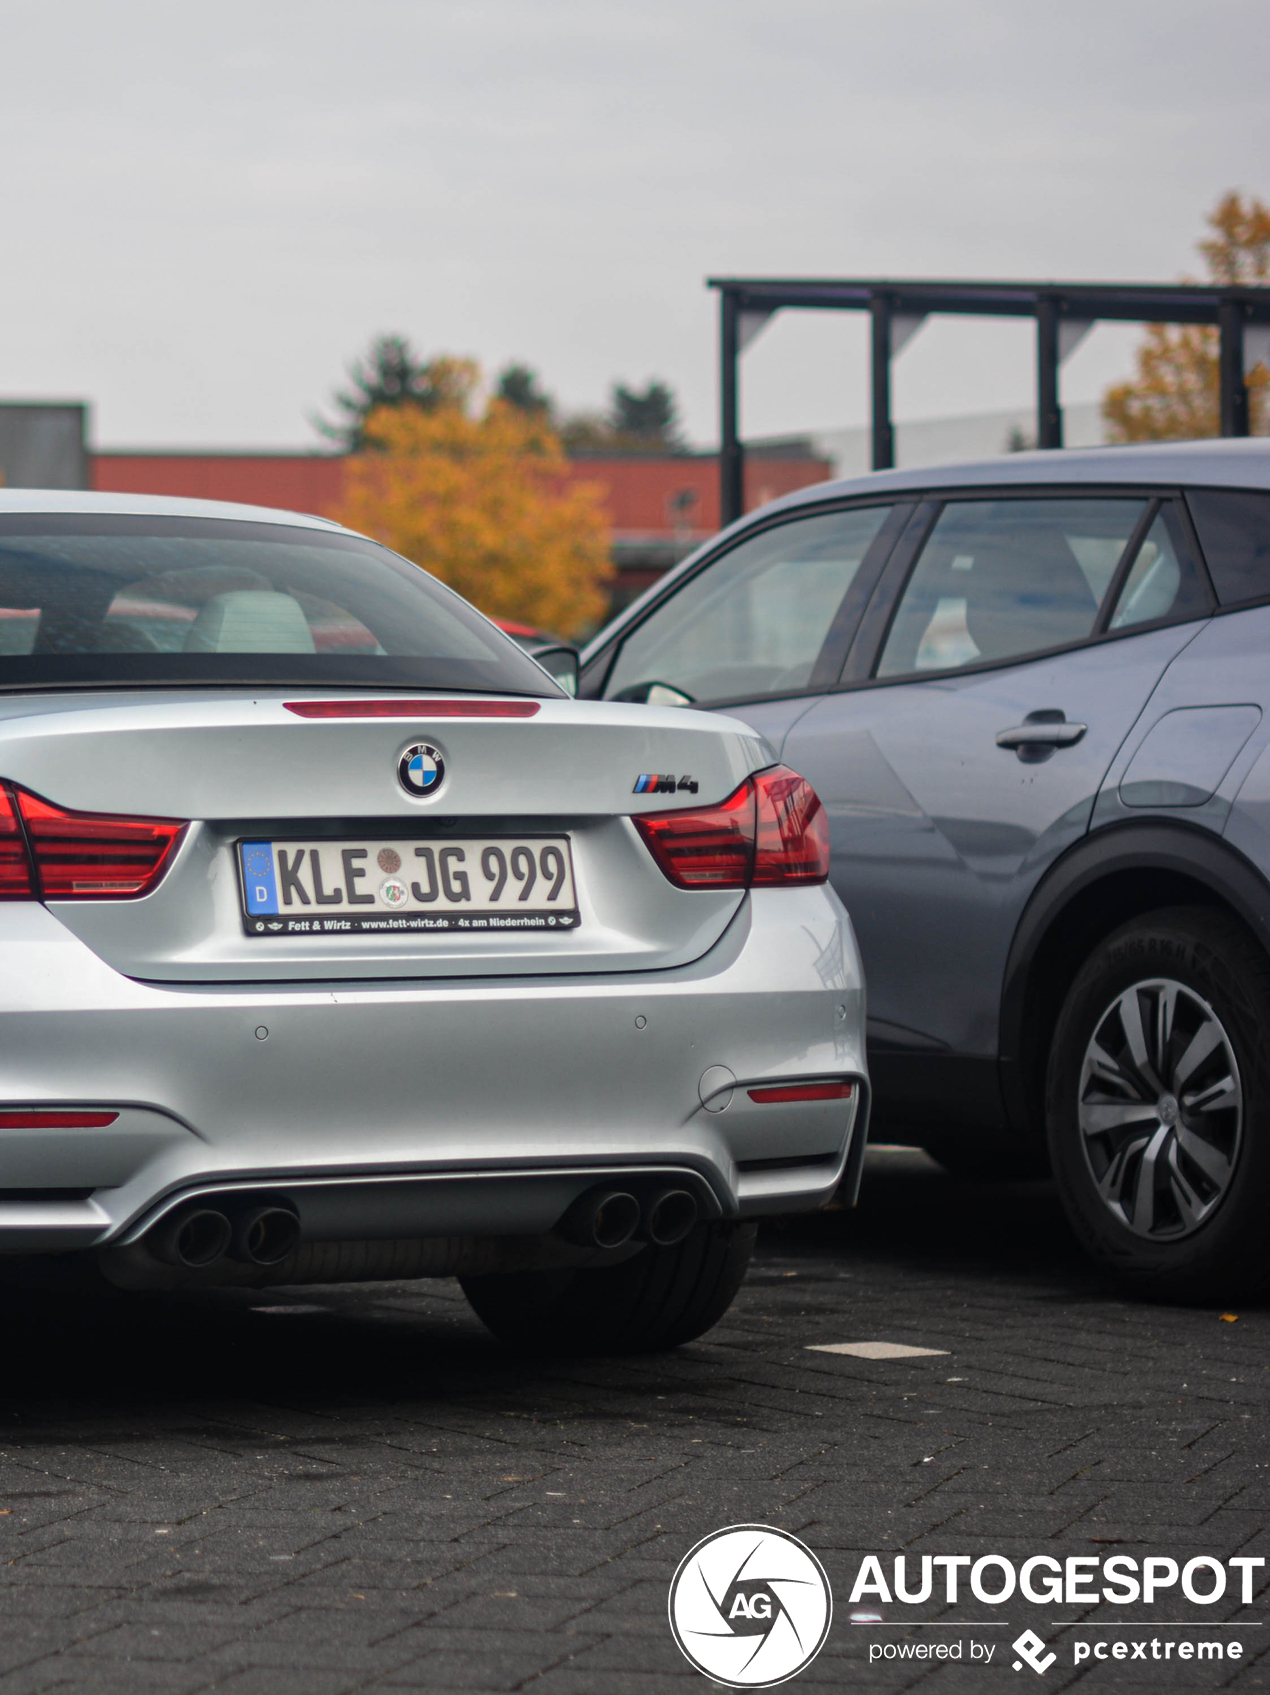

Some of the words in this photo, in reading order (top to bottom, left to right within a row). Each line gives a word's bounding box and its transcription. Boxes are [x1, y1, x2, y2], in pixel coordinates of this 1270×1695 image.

[402, 745, 443, 763] BMW
[651, 773, 699, 794] M4
[277, 848, 376, 906] KLE
[411, 846, 472, 903] JG
[480, 846, 567, 902] 999
[255, 886, 268, 902] D
[288, 920, 310, 931] Fett
[312, 920, 322, 930] &
[323, 919, 352, 930] Wirtz
[361, 917, 449, 929] www.fett-wirtz.de
[458, 918, 470, 927] 4x
[472, 918, 488, 927] am
[489, 916, 546, 927] Niederrhein
